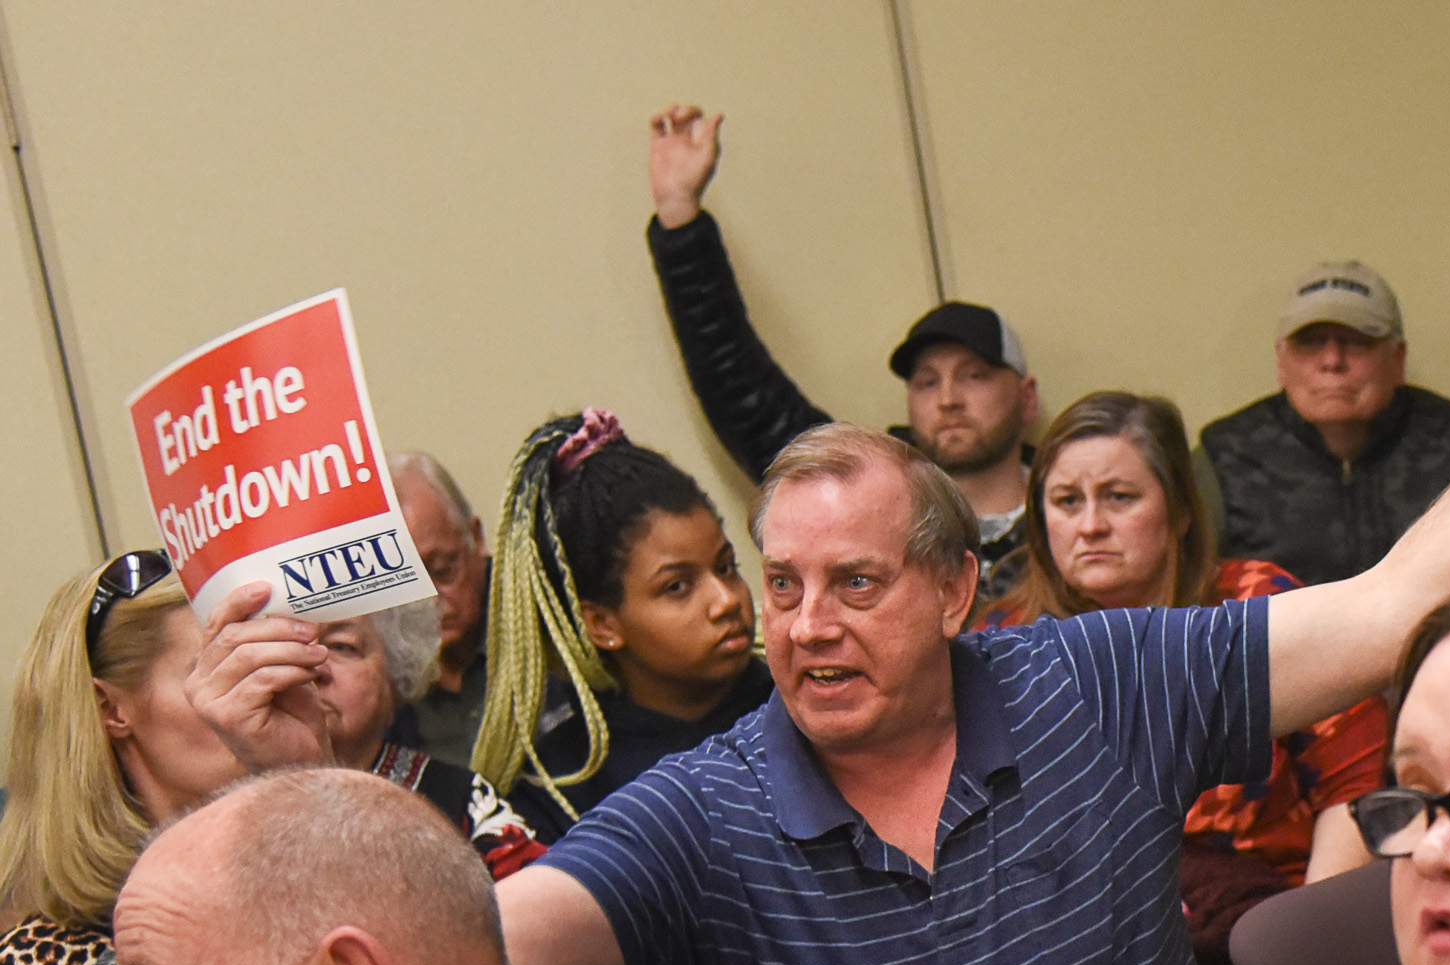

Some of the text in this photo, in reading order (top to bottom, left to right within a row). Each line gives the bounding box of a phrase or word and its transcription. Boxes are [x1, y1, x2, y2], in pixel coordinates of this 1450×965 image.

[153, 366, 307, 476] End the
[160, 420, 371, 571] Shutdown!
[279, 532, 405, 599] NTEU
[304, 593, 332, 607] National
[332, 587, 361, 600] Treasury
[361, 577, 396, 591] Employees
[396, 570, 416, 580] Union
